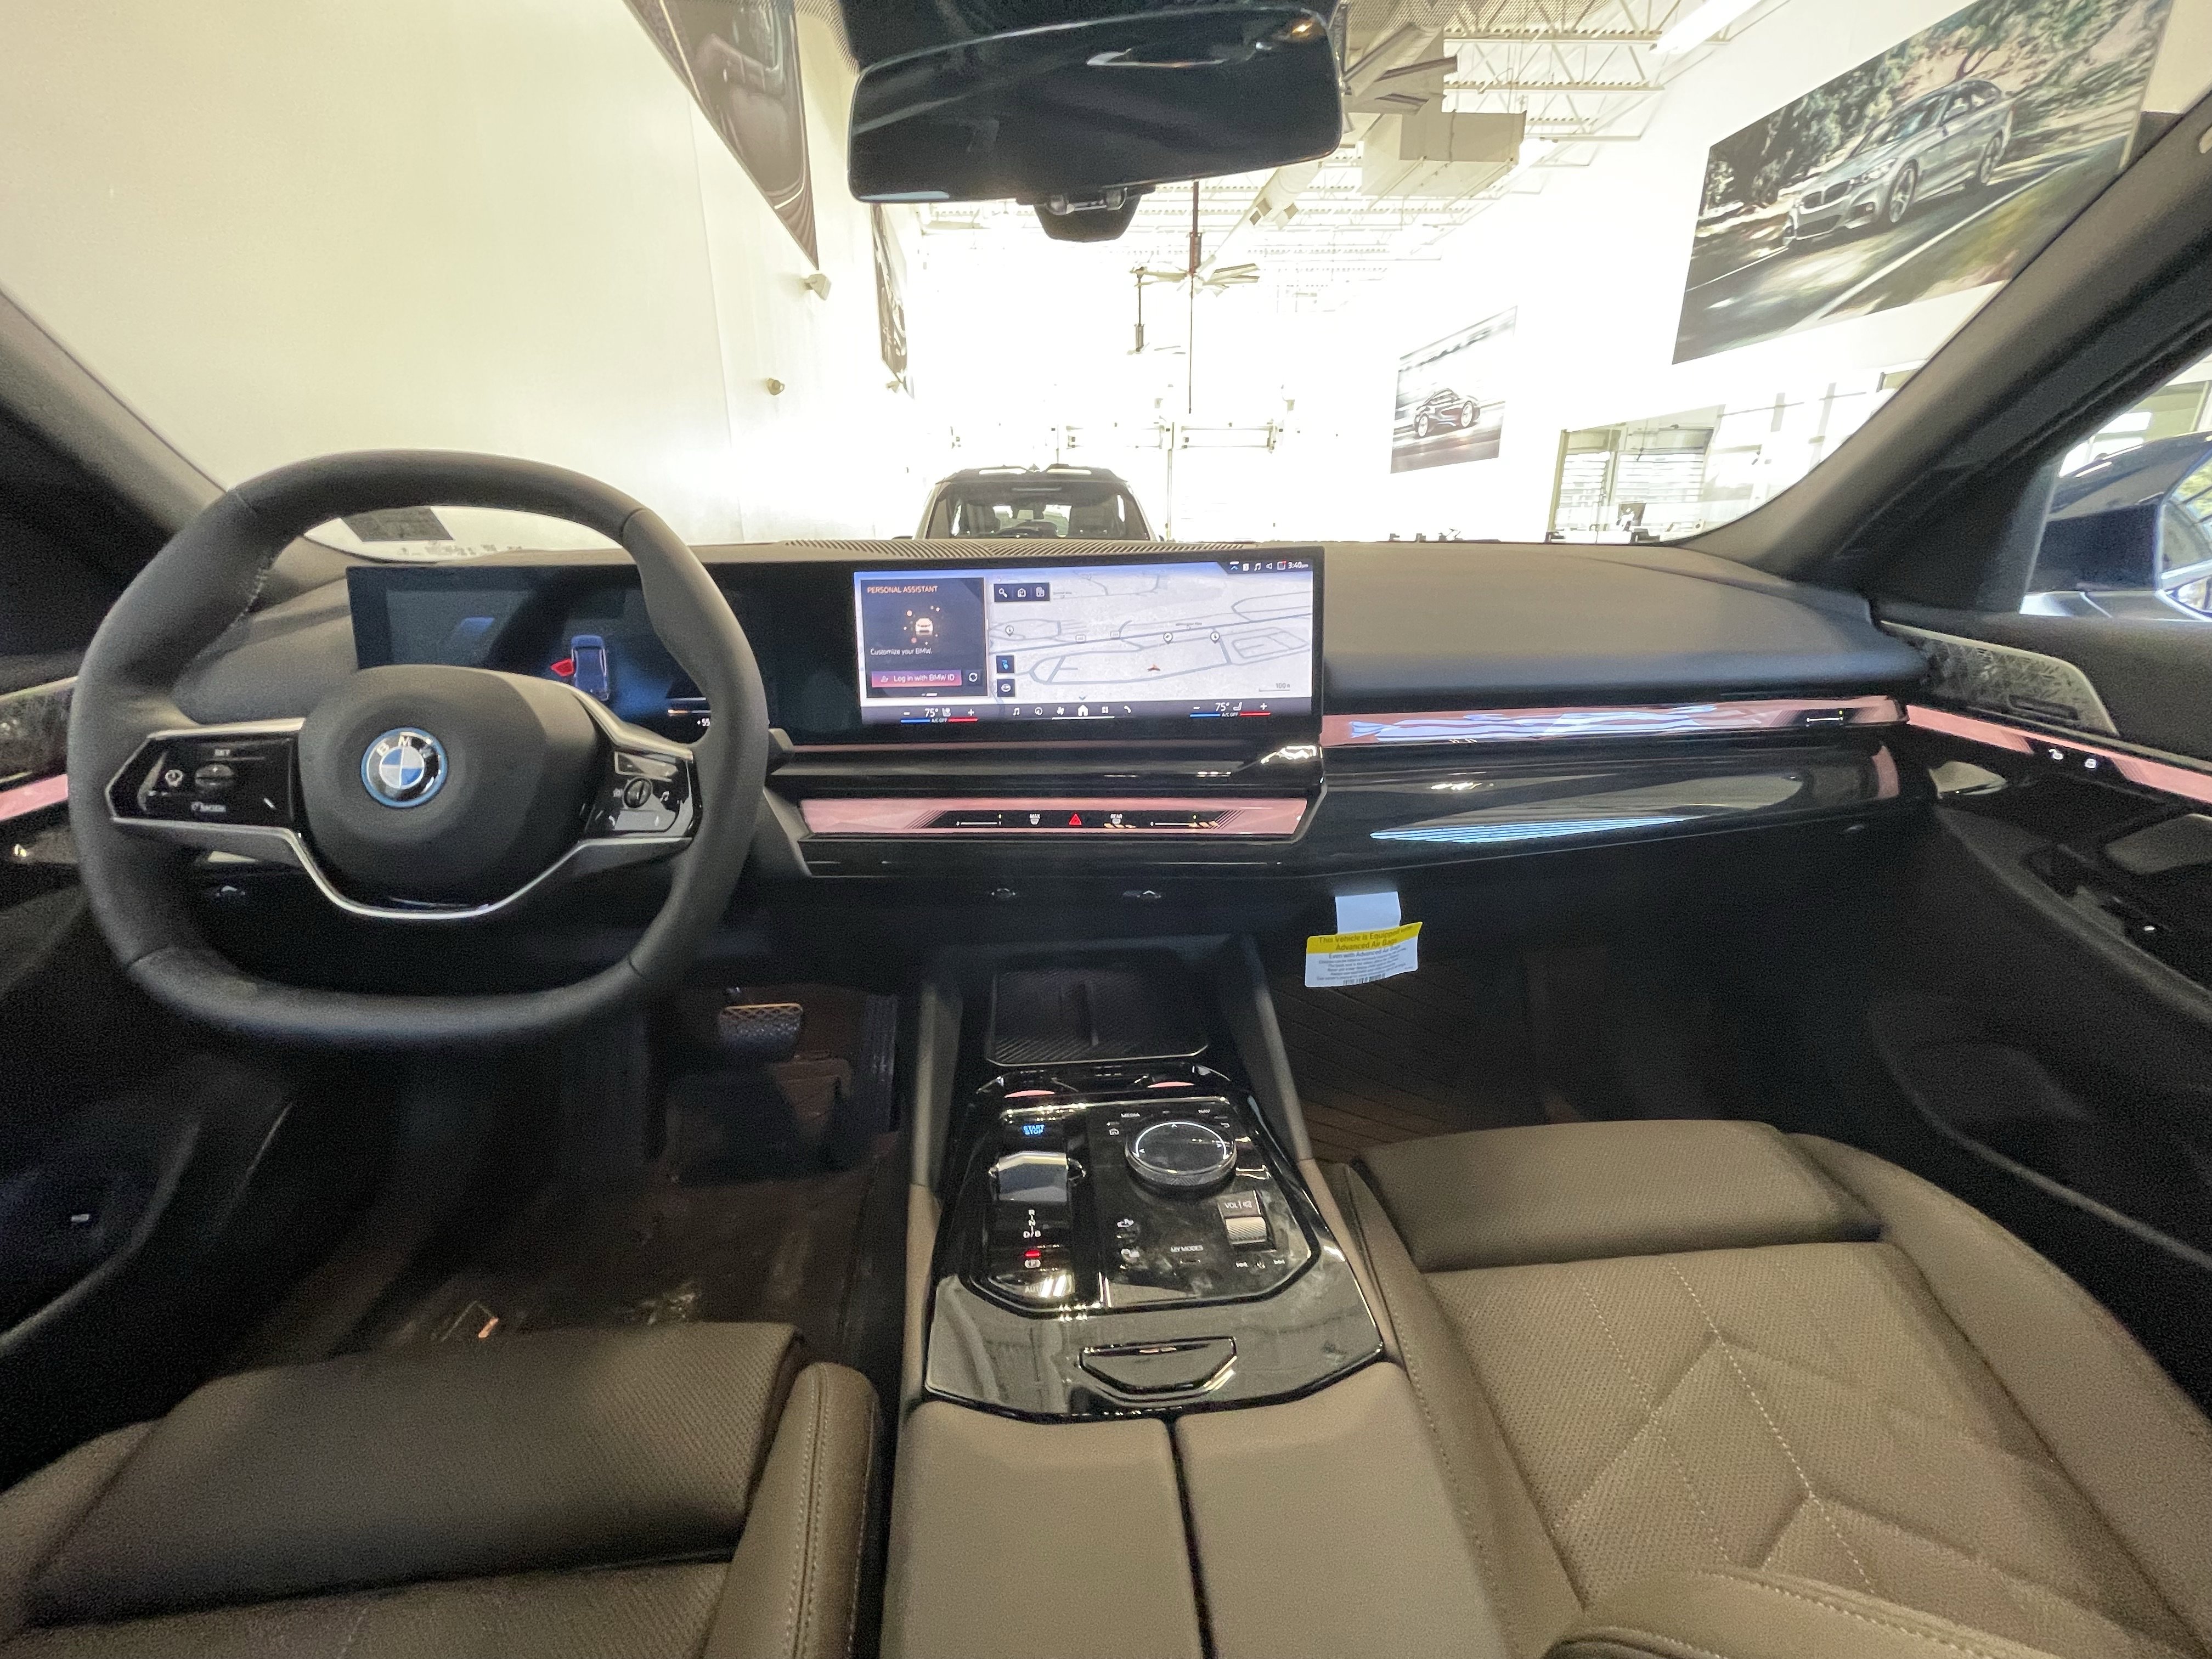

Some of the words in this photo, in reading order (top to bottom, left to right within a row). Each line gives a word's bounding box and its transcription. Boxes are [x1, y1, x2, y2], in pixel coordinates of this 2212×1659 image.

[1215, 702, 1229, 712] 75°
[924, 708, 939, 717] 75°
[1370, 929, 1397, 940] Equipped
[1335, 941, 1369, 950] Advanced
[1356, 949, 1382, 957] Advanced
